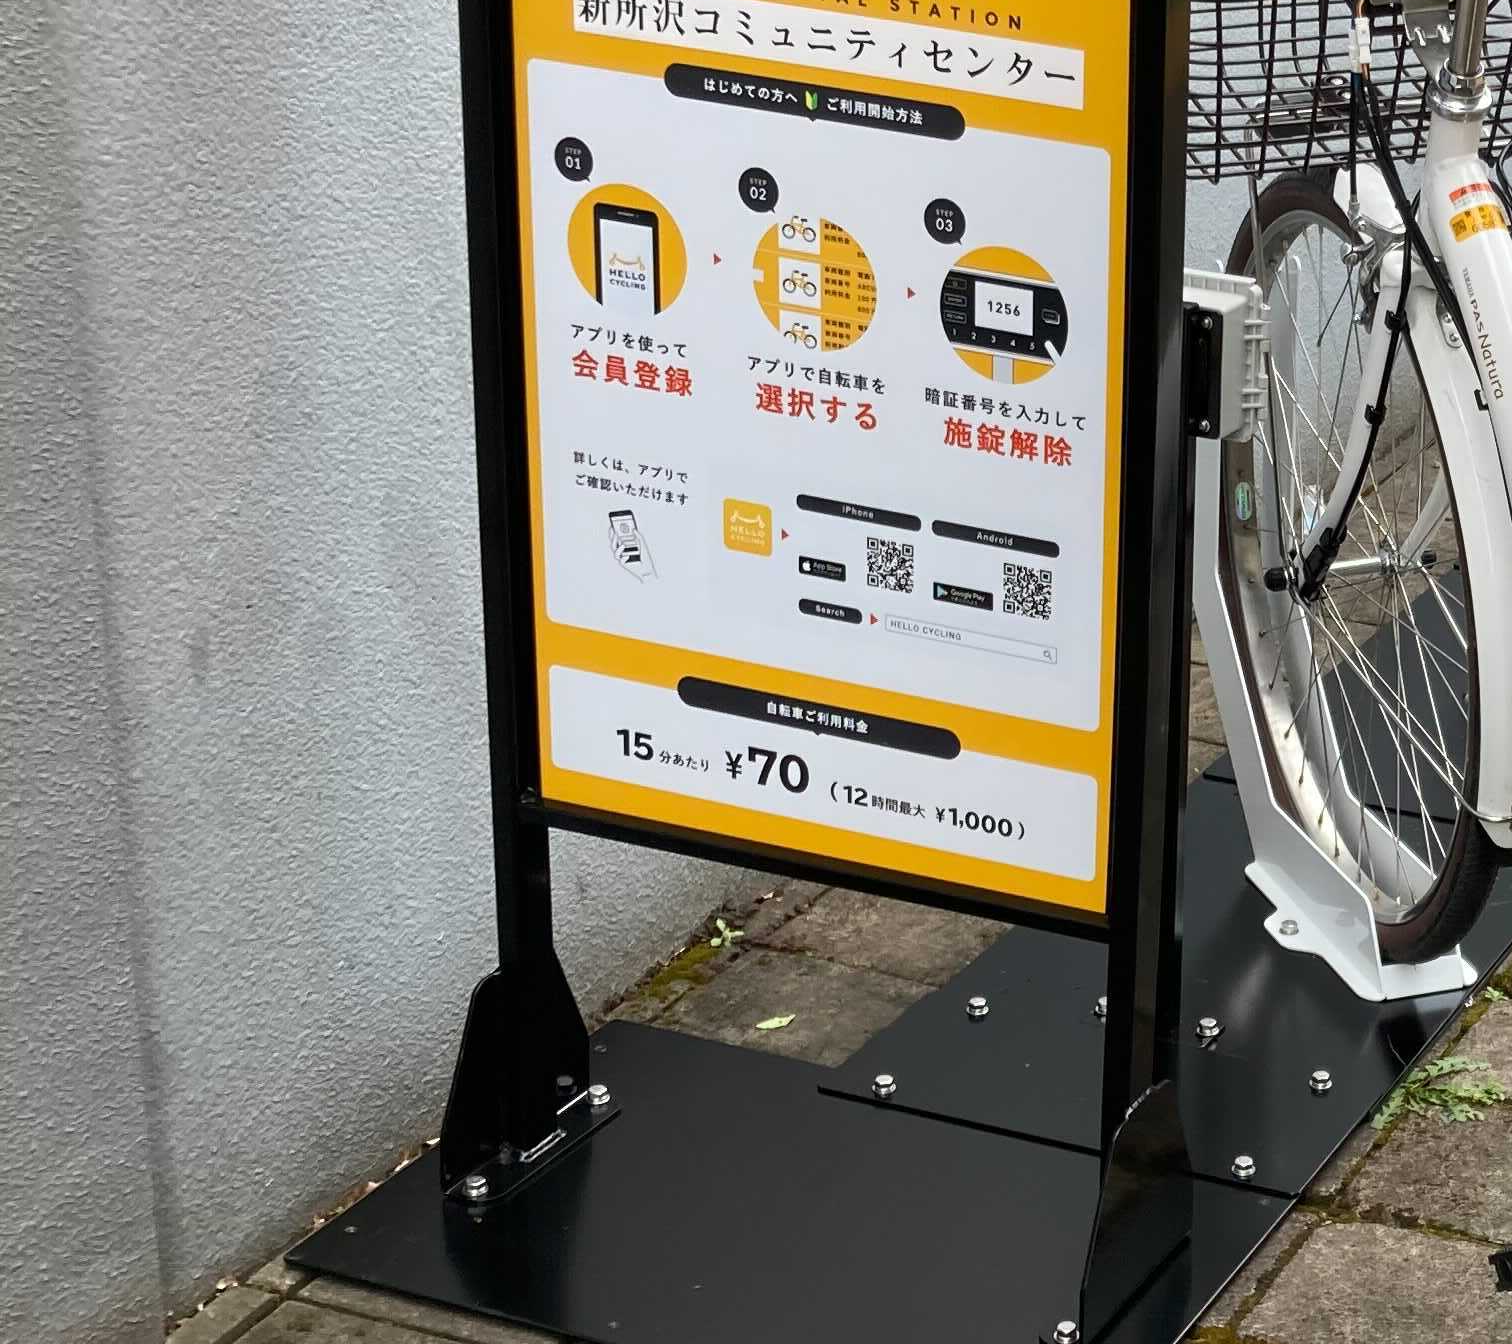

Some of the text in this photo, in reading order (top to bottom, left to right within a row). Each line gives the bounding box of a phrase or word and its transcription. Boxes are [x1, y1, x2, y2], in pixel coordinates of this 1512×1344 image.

[702, 76, 924, 126] はじめての方へ ご利用開始方法
[564, 155, 582, 171] 01
[749, 186, 767, 201] 02
[935, 217, 953, 233] 03
[608, 268, 647, 283] HELLO
[609, 278, 647, 292] CYCLING
[986, 299, 1022, 318] 1256
[570, 323, 689, 359] アプリを使って
[571, 348, 695, 398] 会員登録
[747, 355, 887, 396] アプリで自転車を
[755, 382, 878, 432] 選択する
[924, 387, 1088, 432] 暗証番号を入力して
[943, 417, 1075, 468] 施錠解除
[573, 449, 690, 486] 詳しくは、アプリで
[574, 473, 690, 508] ご確認いただけます
[841, 504, 875, 520] iPhone
[976, 531, 1014, 547] Android
[815, 604, 846, 618] Search
[890, 620, 962, 641] HELLO CYCLING
[766, 699, 869, 735] 自転車ご利用料金
